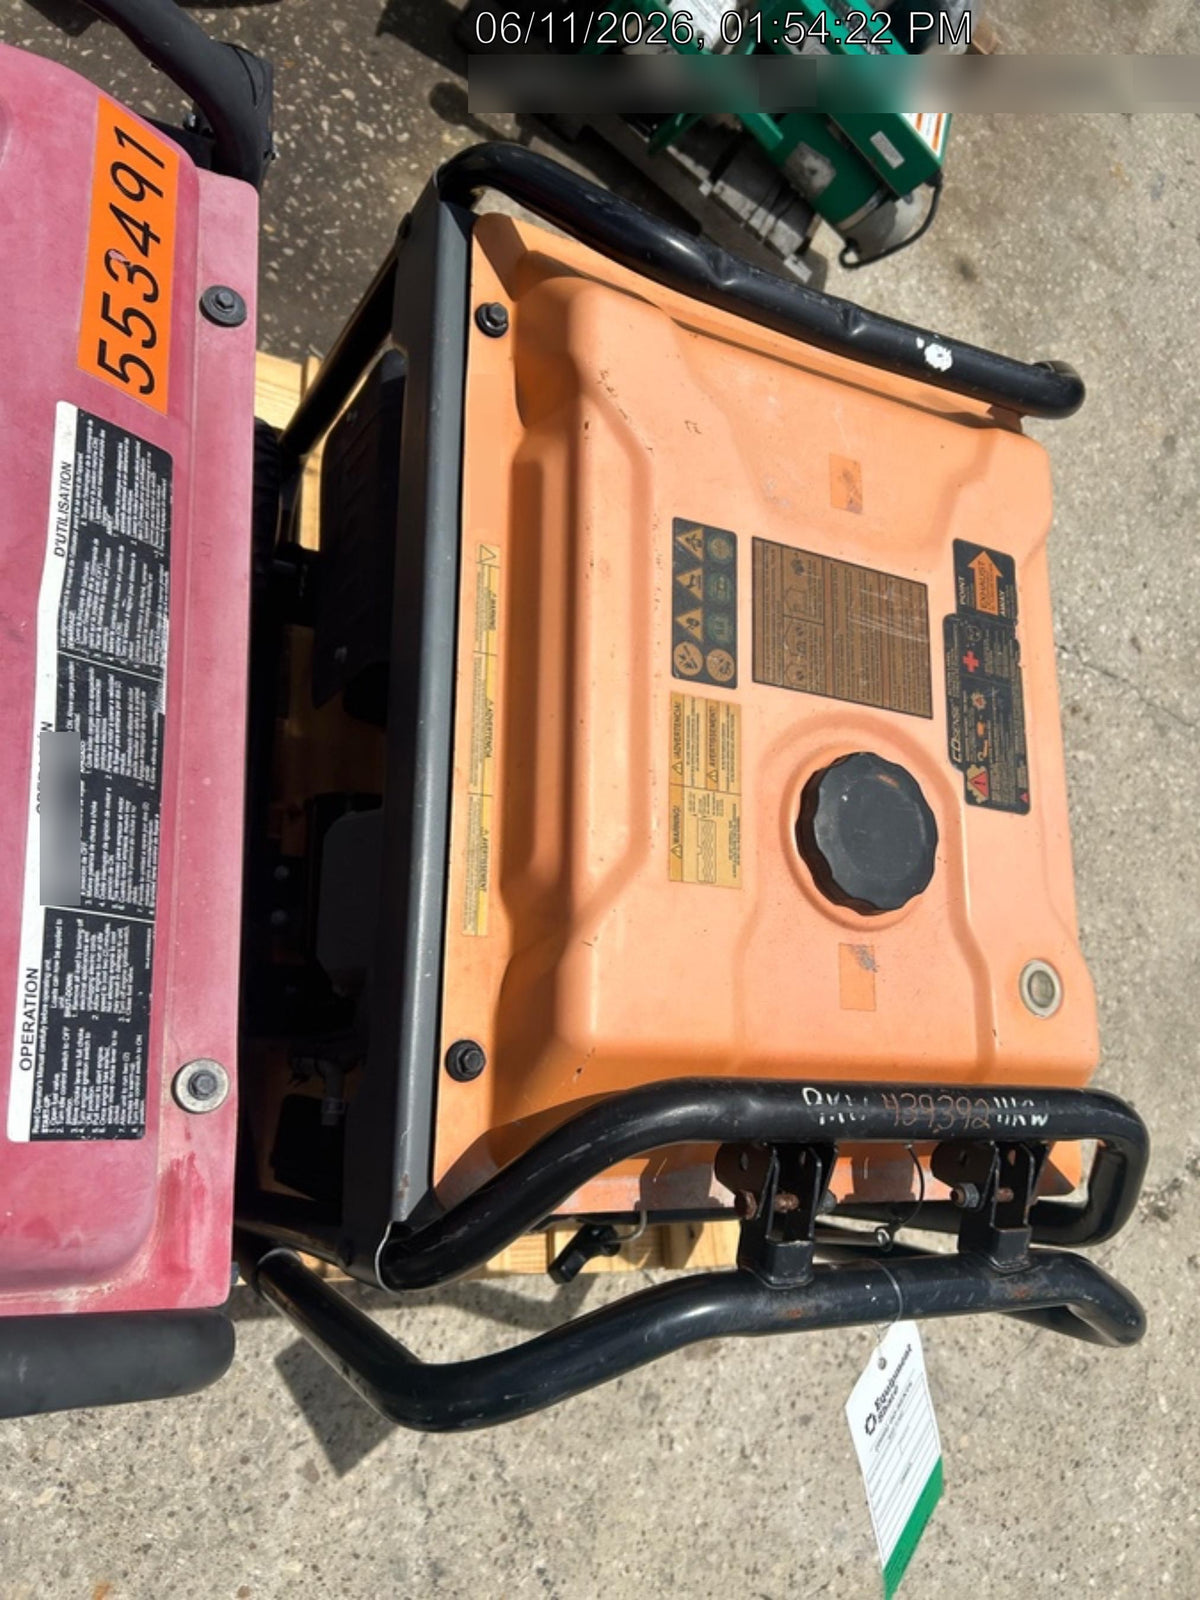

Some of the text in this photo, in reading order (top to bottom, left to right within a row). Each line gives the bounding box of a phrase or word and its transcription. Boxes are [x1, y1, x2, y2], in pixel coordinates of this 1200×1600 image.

[97, 124, 167, 397] 553491
[53, 460, 72, 558] D'UTILISATION
[958, 576, 966, 605] POINT
[978, 560, 987, 608] EXHAUST
[999, 590, 1007, 617] AWAY
[19, 967, 39, 1071] OPERATION
[874, 1343, 913, 1412] Equipment
